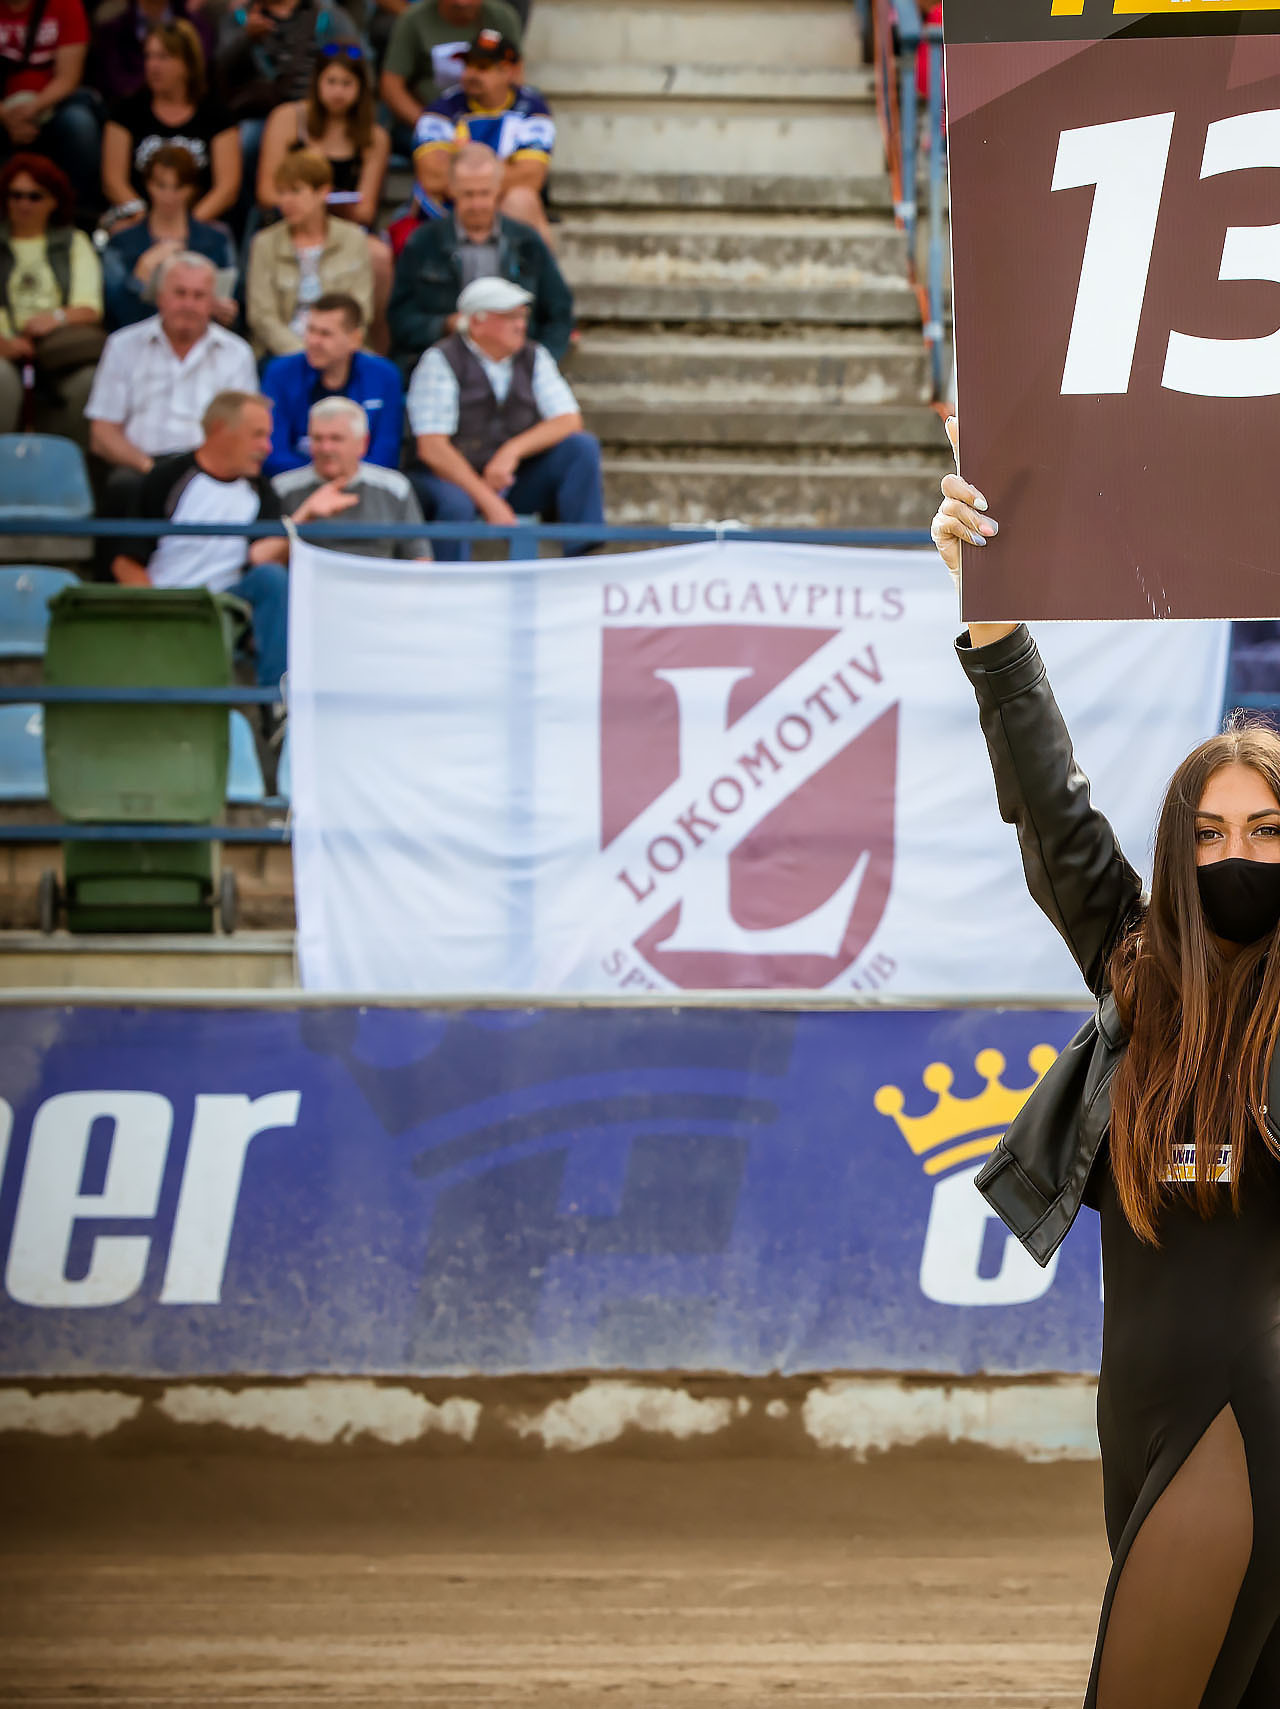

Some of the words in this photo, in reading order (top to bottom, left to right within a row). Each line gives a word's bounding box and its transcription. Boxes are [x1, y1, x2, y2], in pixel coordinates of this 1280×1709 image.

[601, 578, 906, 621] DAUGAVPILS
[616, 643, 885, 903] LOKOMOTIV
[0, 1090, 301, 1308] er
